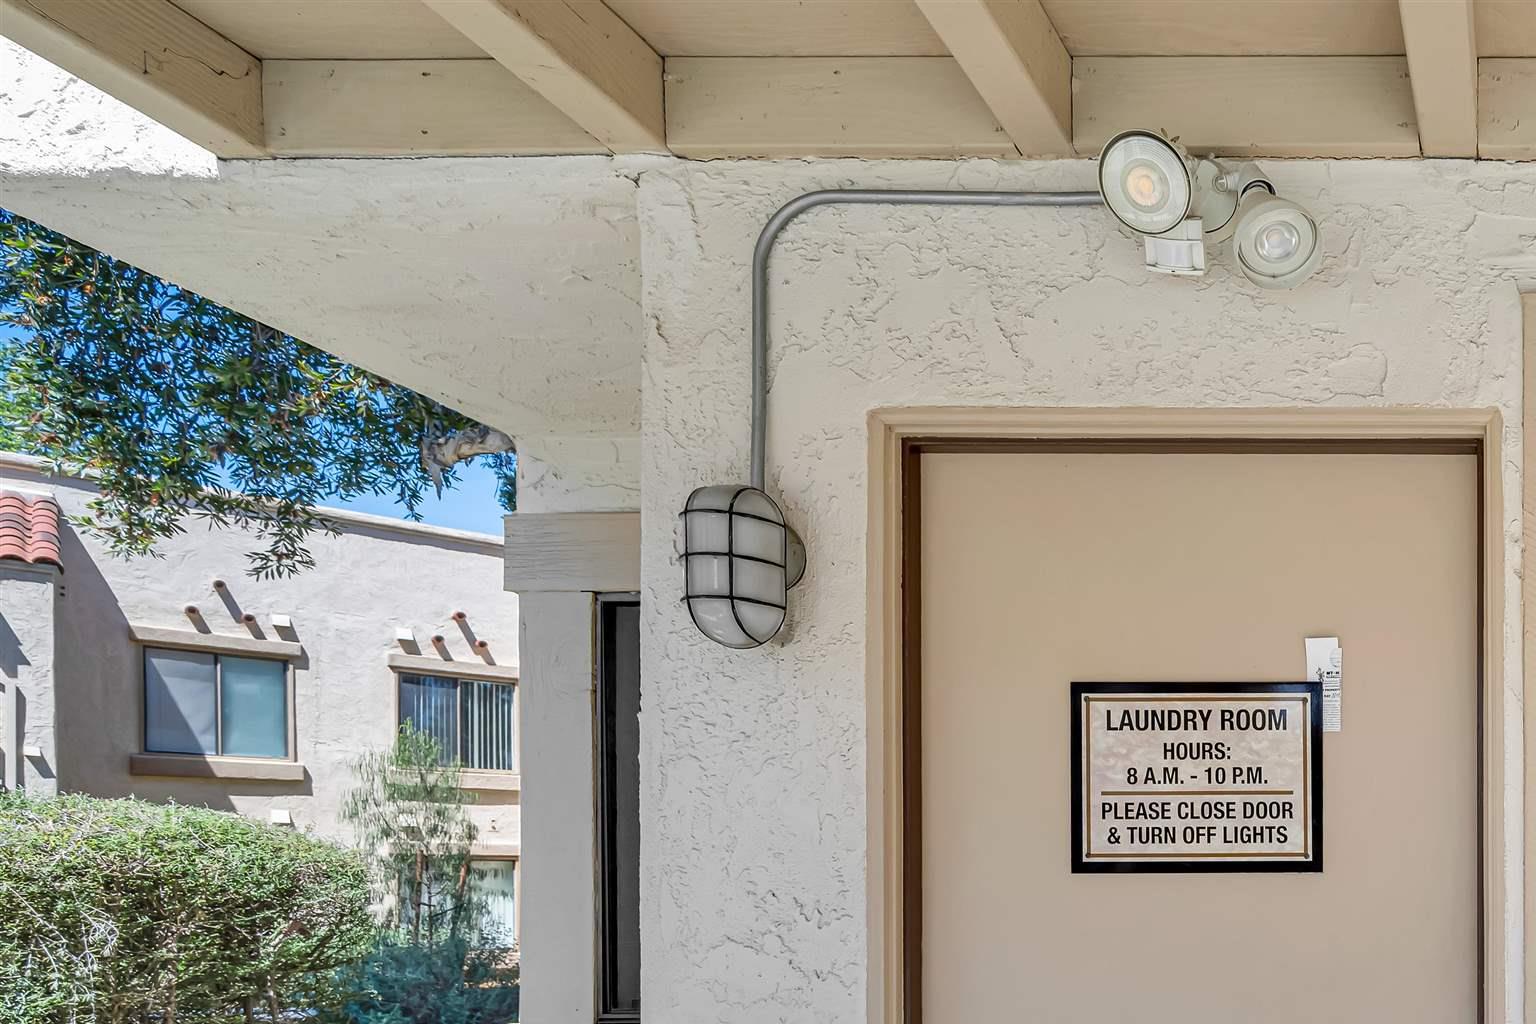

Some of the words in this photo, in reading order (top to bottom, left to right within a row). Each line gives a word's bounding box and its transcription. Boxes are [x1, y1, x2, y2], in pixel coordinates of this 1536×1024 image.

[1105, 709, 1212, 731] LAUNDRY
[1220, 709, 1287, 731] ROOM
[1163, 742, 1231, 760] HOURS:
[1126, 767, 1138, 785] 8
[1143, 767, 1184, 785] A.M.
[1204, 767, 1226, 785] 10
[1232, 767, 1268, 785] P.M.
[1101, 802, 1171, 820] PLEASE
[1177, 802, 1236, 820] CLOSE
[1243, 802, 1293, 819] DOOR
[1107, 827, 1121, 844] &
[1127, 827, 1176, 844] TURN
[1183, 827, 1217, 844] OFF
[1223, 826, 1288, 844] LIGHTS
